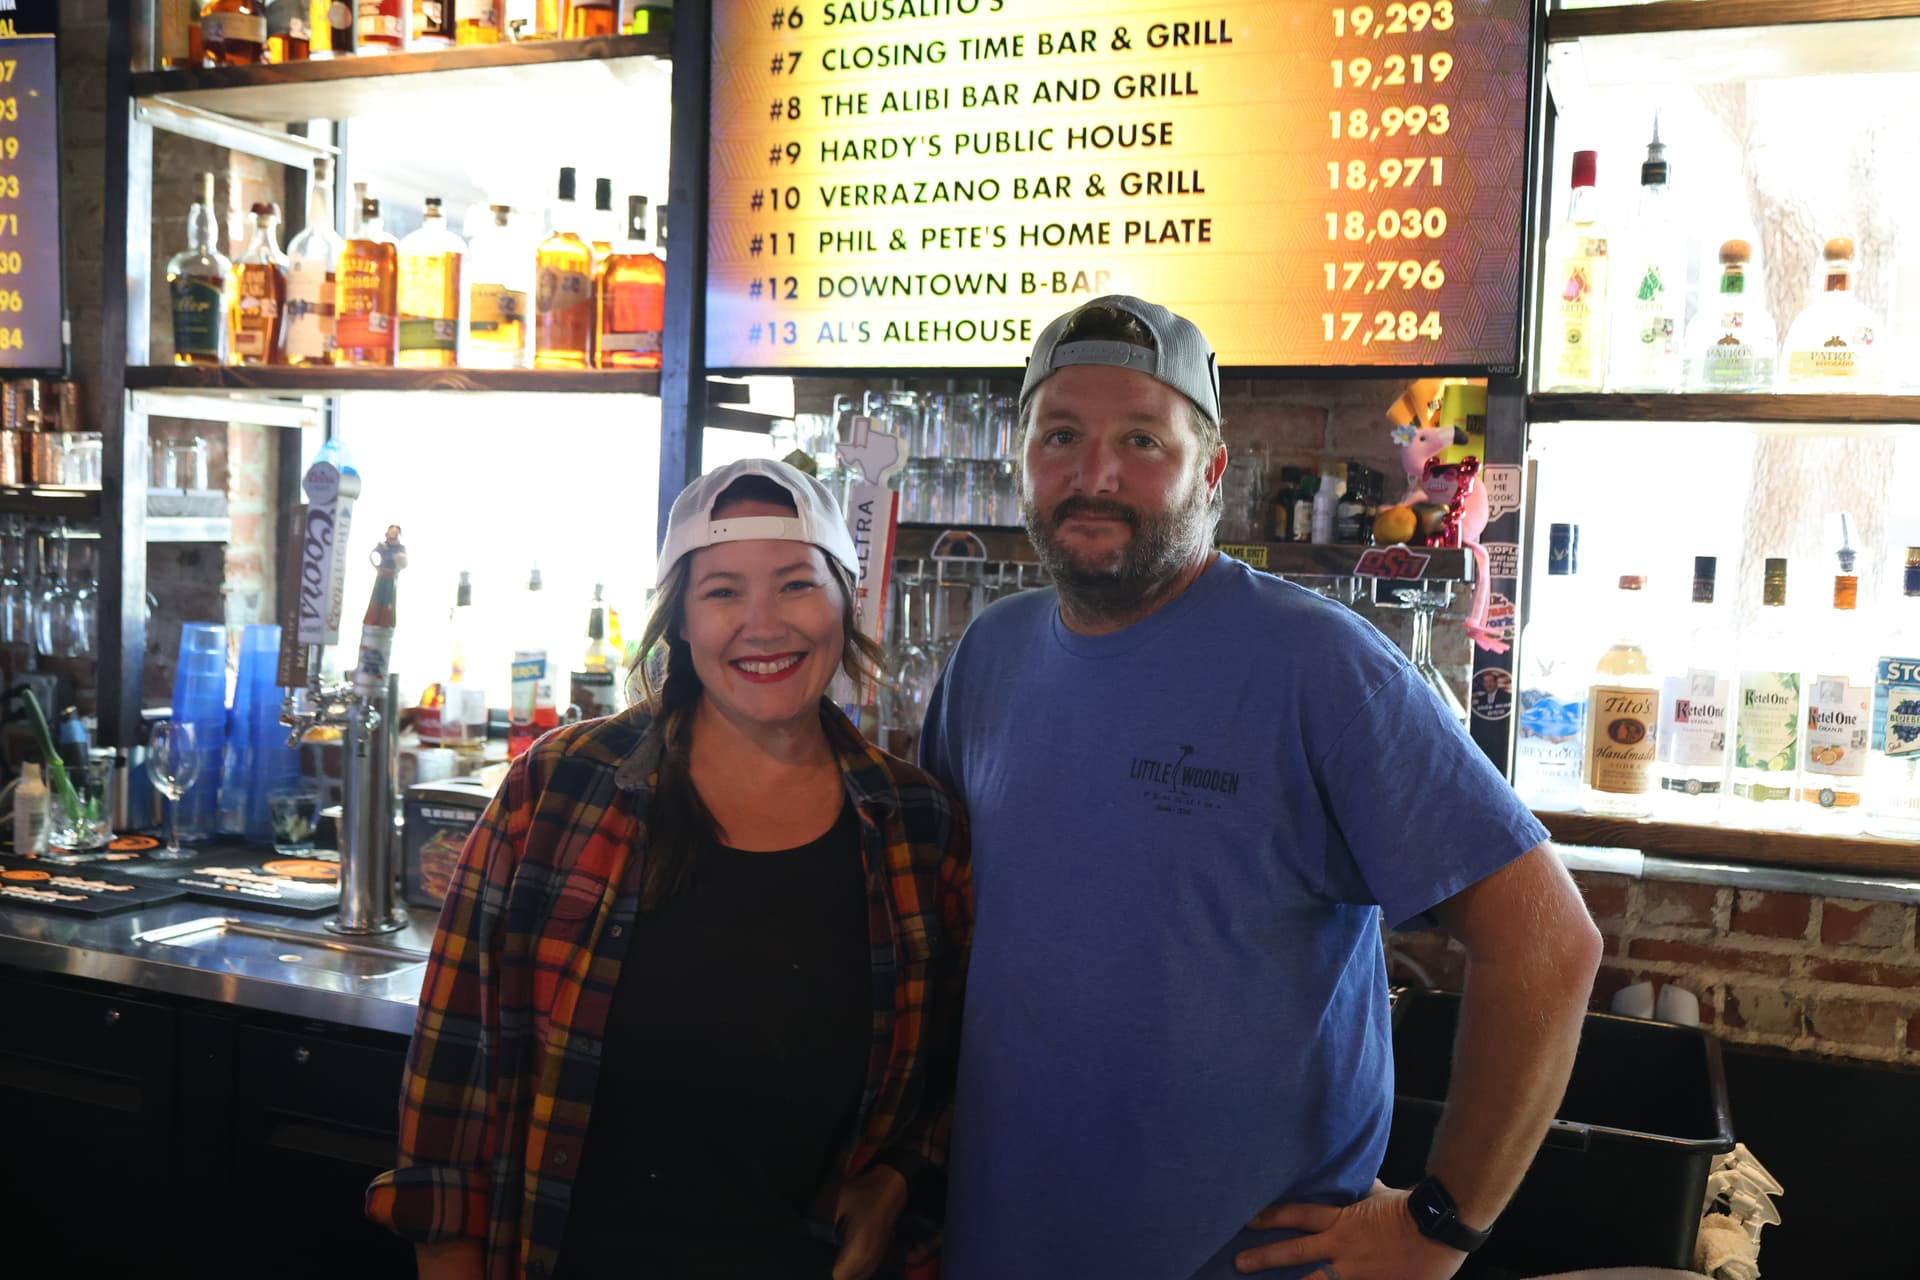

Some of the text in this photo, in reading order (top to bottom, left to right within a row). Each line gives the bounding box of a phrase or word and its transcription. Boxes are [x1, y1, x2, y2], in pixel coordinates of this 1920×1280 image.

[771, 0, 1454, 39] #6 SAUSALITOS 19,293
[770, 20, 1454, 91] #7 CLOSING TIME BAR & GRILL 19,219
[769, 72, 1450, 142] #8 THE ALIBI BAR AND GRILL 18,993
[769, 122, 1443, 193] #9 HARDY'S PUBLIC HOUSE 18,971
[750, 170, 1447, 244] #10 VERRAZANO BAR & GRILL 18,030
[749, 218, 1445, 295] #11 PHIL & PETE'S HOME PLATE 17,796
[748, 318, 1032, 346] #13 AL'S ALEHOUSE
[749, 269, 1443, 347] #12 DOWNTOWN B-BAR 17,284
[1487, 366, 1515, 374] VIZIO
[301, 508, 336, 620] Coors
[855, 500, 875, 580] ULTRA
[1604, 695, 1653, 714] Tito's
[1676, 700, 1706, 720] Ketel
[1707, 704, 1724, 718] One
[1745, 689, 1790, 706] Ketel One
[1808, 706, 1834, 725] Ketel
[1836, 711, 1858, 726] One
[1130, 757, 1239, 794] LITTLE WOODEN
